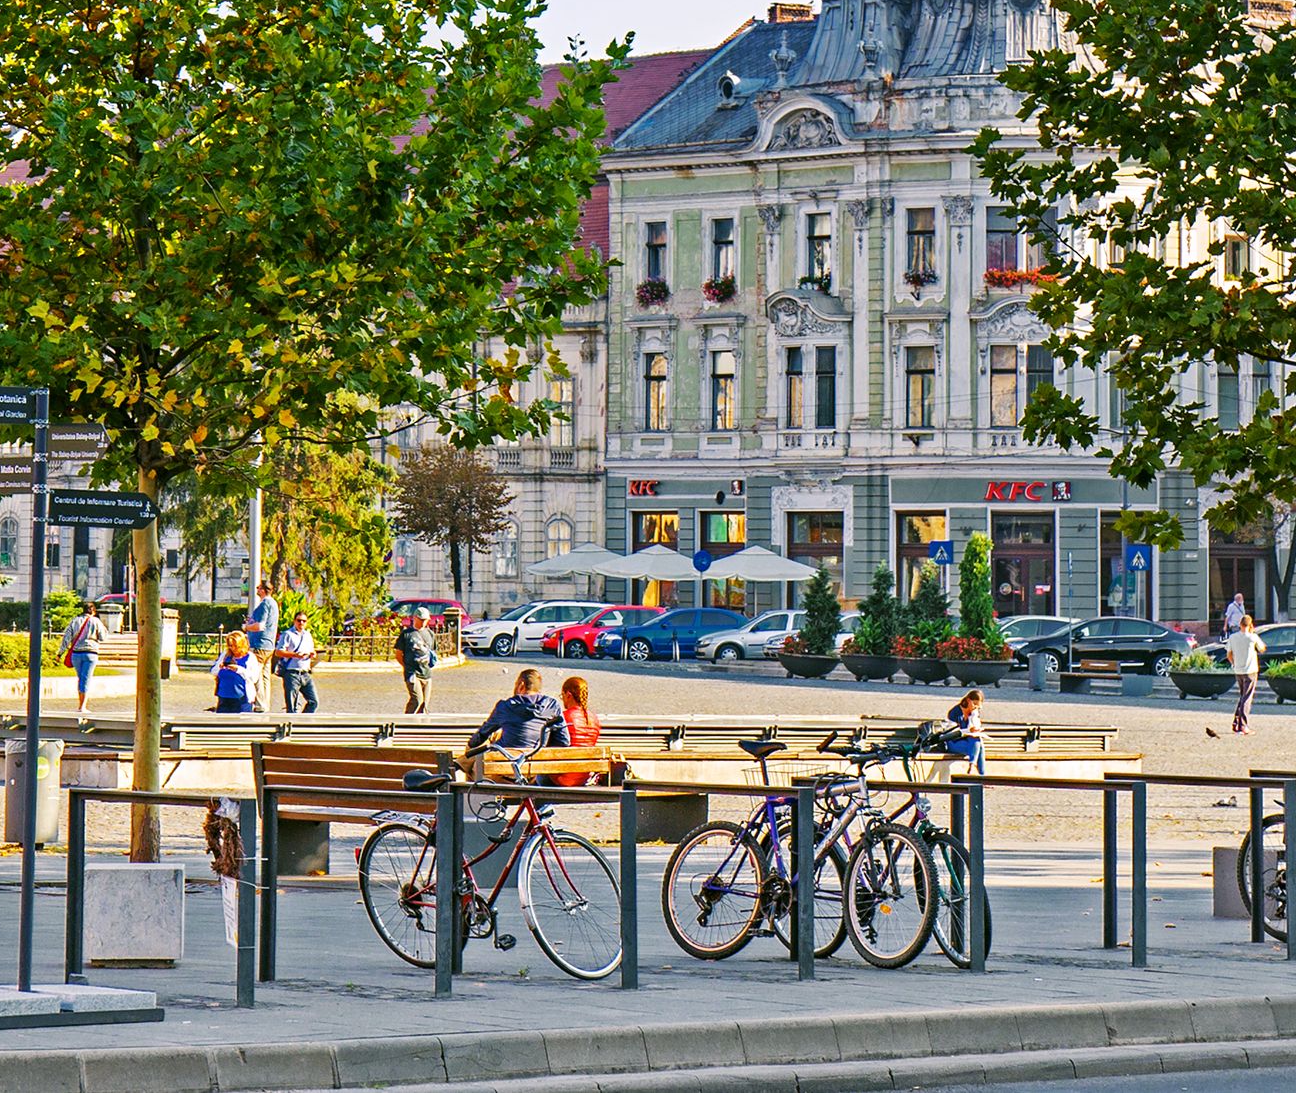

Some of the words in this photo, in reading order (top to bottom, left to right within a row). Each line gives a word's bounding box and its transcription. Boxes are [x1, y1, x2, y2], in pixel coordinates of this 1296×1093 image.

[5, 410, 27, 418] Garden
[628, 479, 657, 495] KFC
[985, 481, 1046, 501] KFC
[54, 496, 77, 504] Centrul
[78, 497, 86, 505] de
[86, 498, 116, 506] Informare
[58, 514, 79, 522] Tourist
[79, 516, 113, 524] Information
[114, 517, 135, 525] Center
